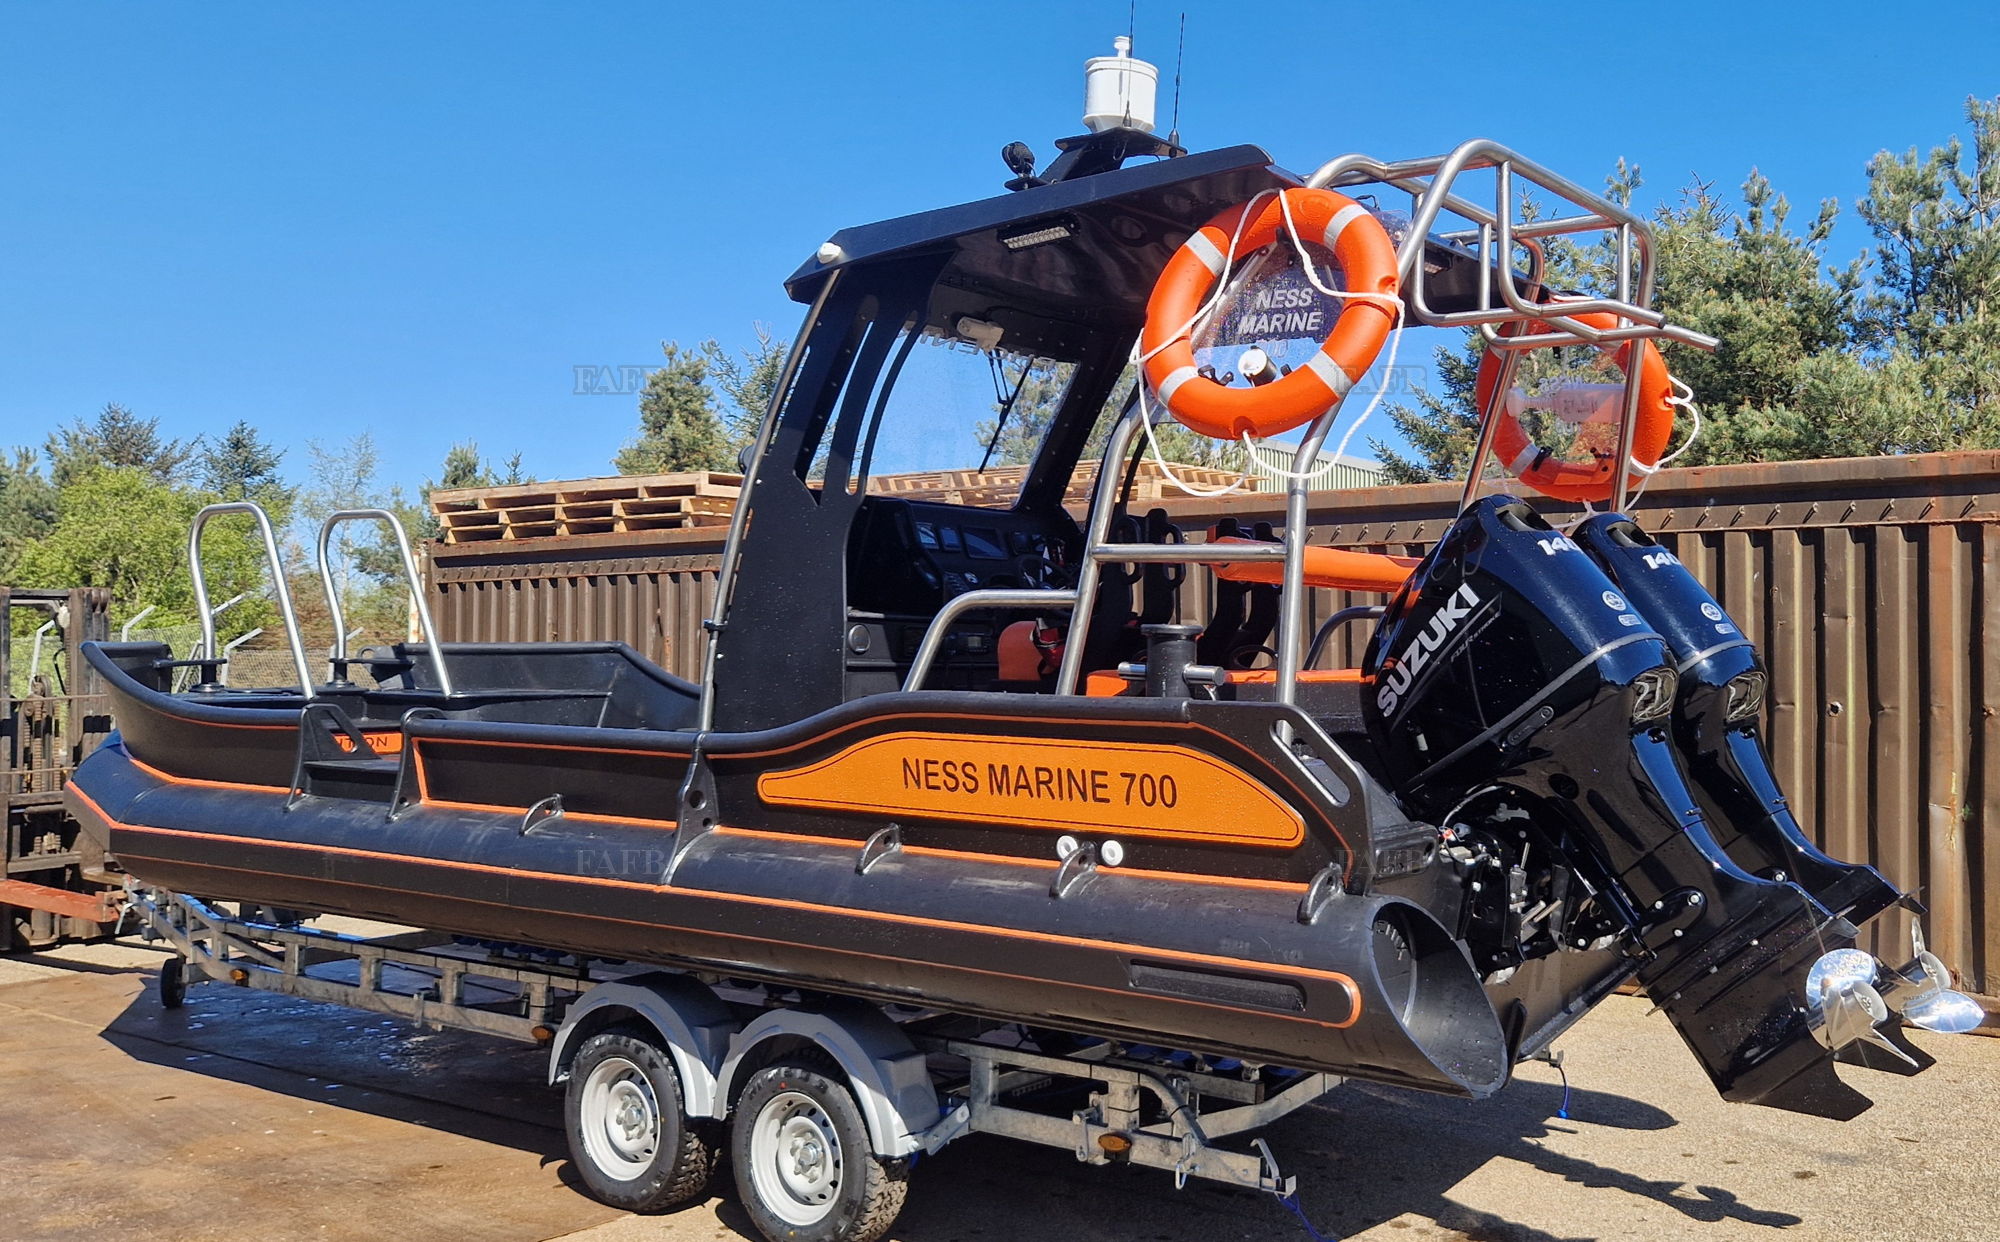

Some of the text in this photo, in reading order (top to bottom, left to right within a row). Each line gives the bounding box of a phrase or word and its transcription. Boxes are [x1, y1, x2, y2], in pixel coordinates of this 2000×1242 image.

[1255, 287, 1314, 310] NESS
[1237, 311, 1323, 335] MARINE
[1377, 582, 1480, 717] SUZUKI
[902, 756, 1178, 809] NESS MARINE 700
